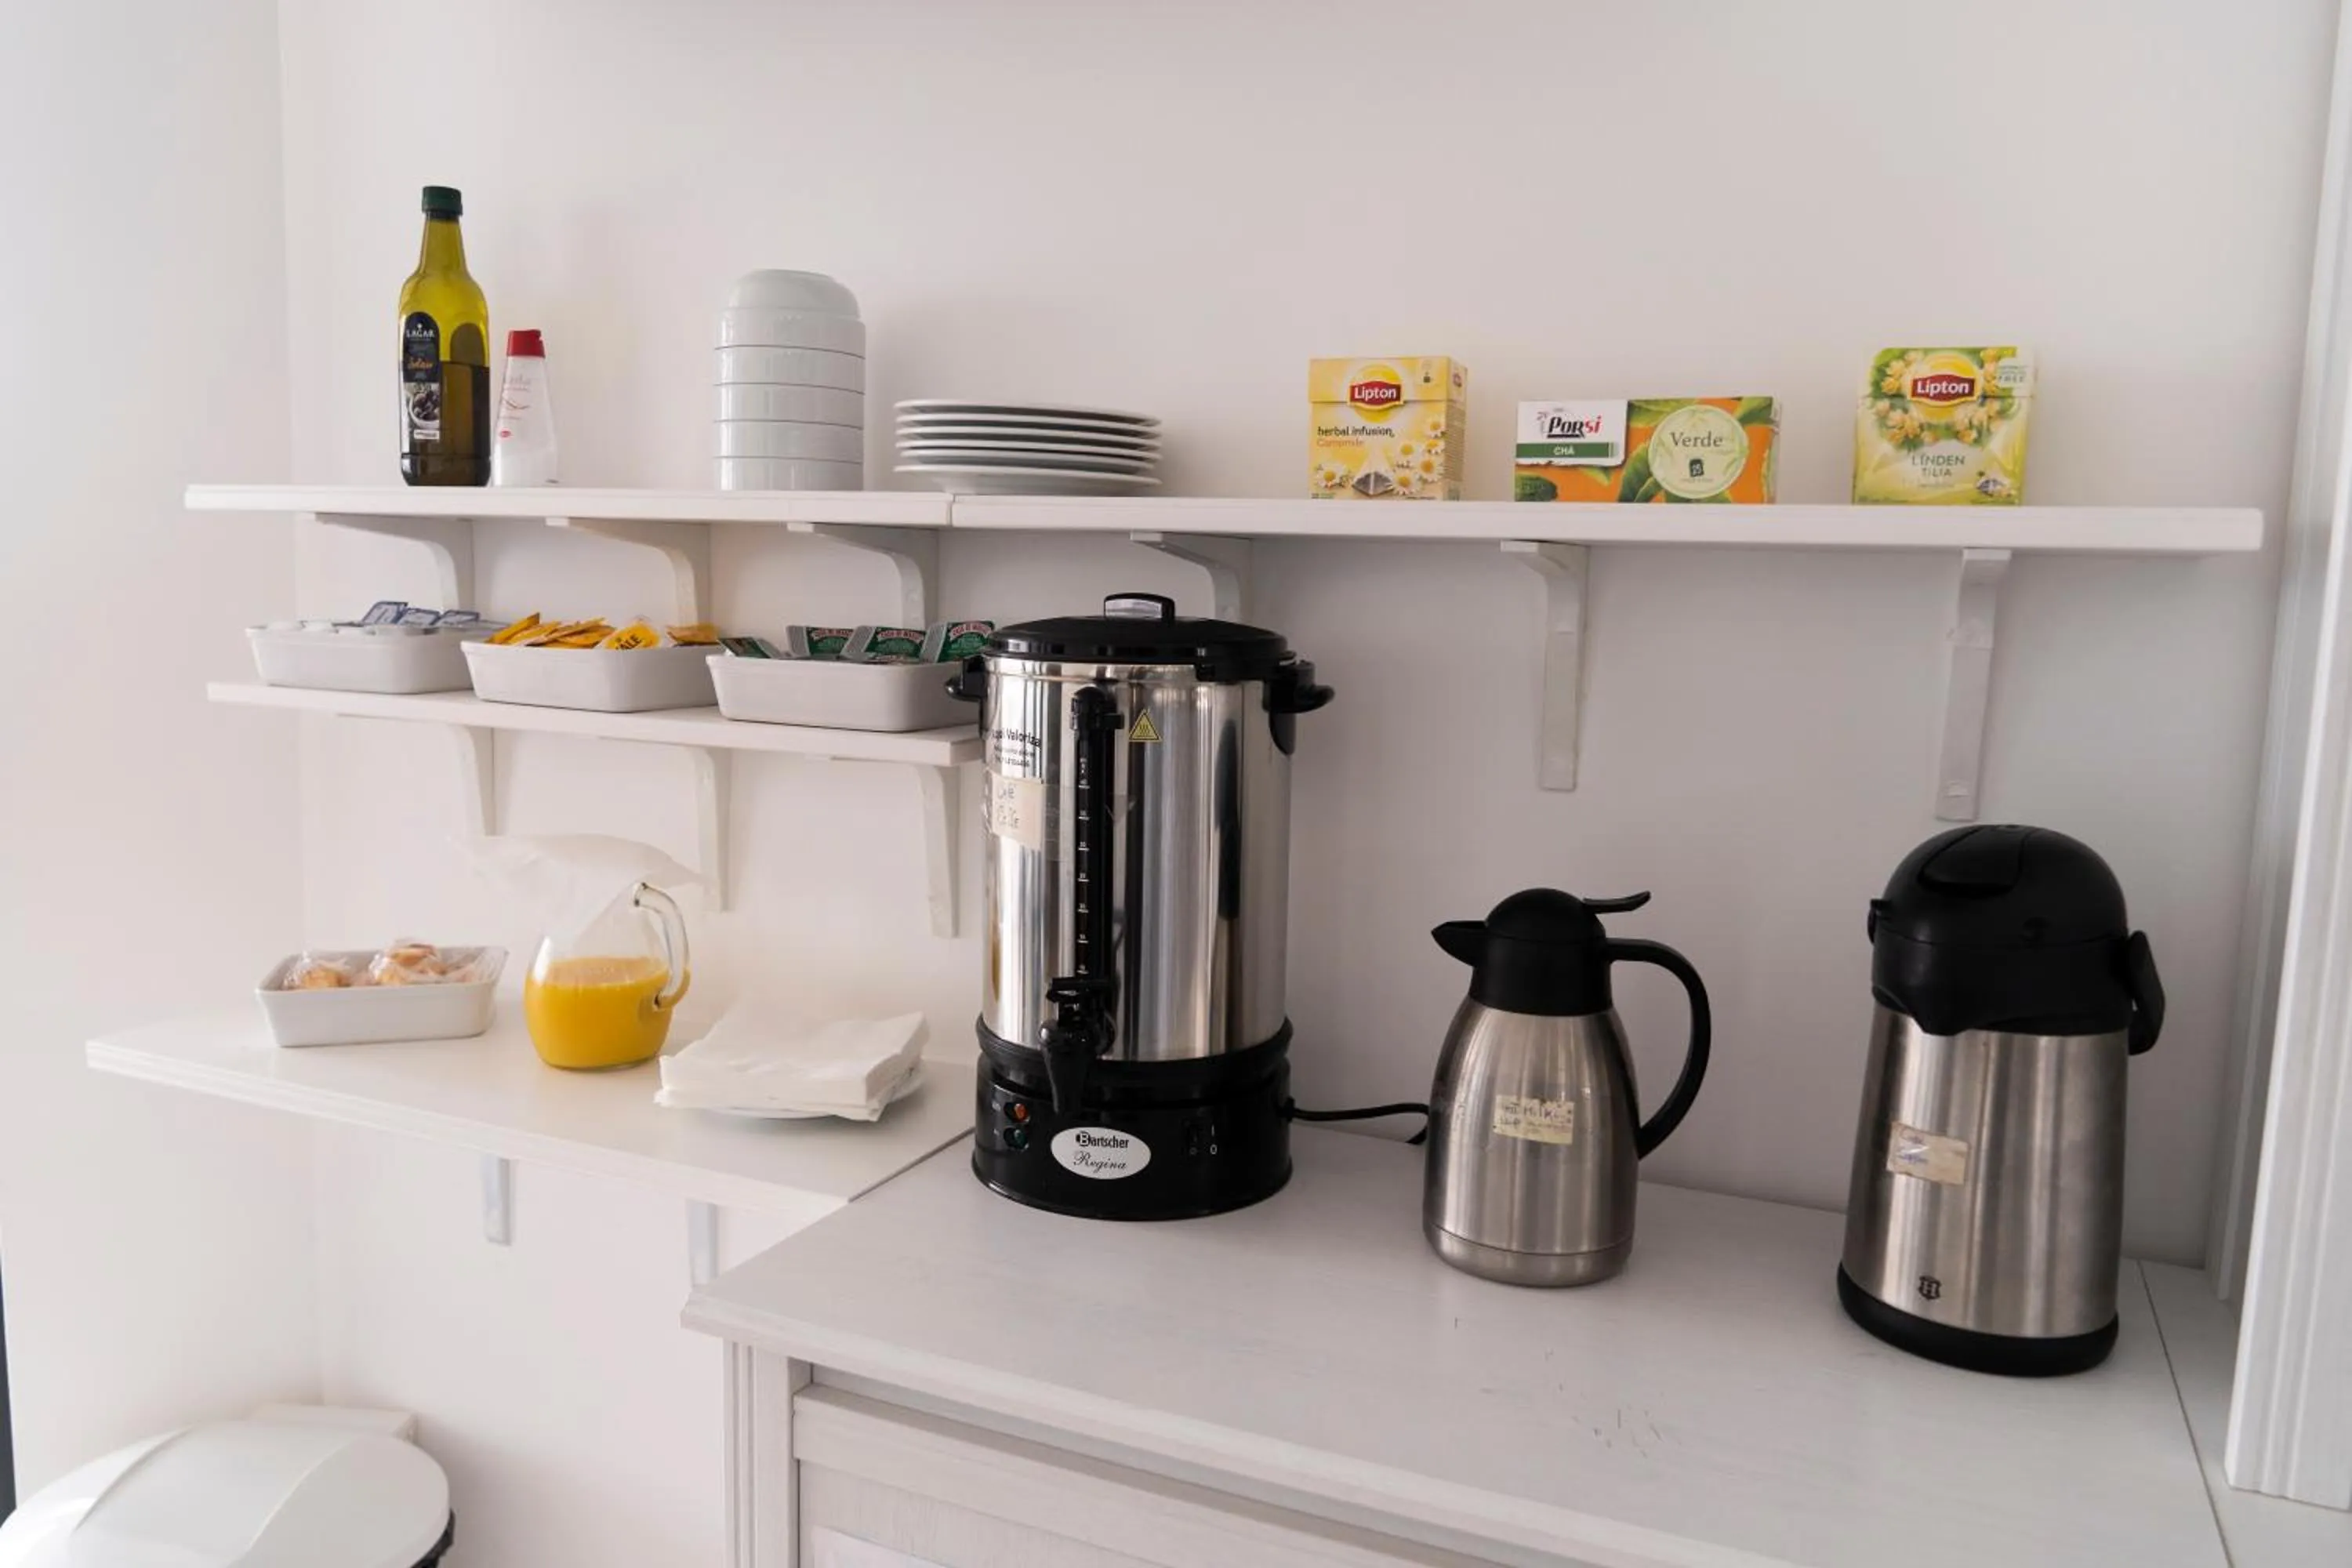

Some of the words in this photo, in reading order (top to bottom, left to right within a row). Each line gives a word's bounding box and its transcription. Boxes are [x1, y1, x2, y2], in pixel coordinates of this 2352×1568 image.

[1354, 387, 1396, 401] Lipton
[1916, 380, 1970, 397] Lipton
[1317, 426, 1348, 437] herbal
[1669, 430, 1723, 448] Verde
[1911, 455, 1965, 466] LINDEN
[1075, 1131, 1130, 1149] Bartscher
[1073, 1150, 1127, 1174] Regina
